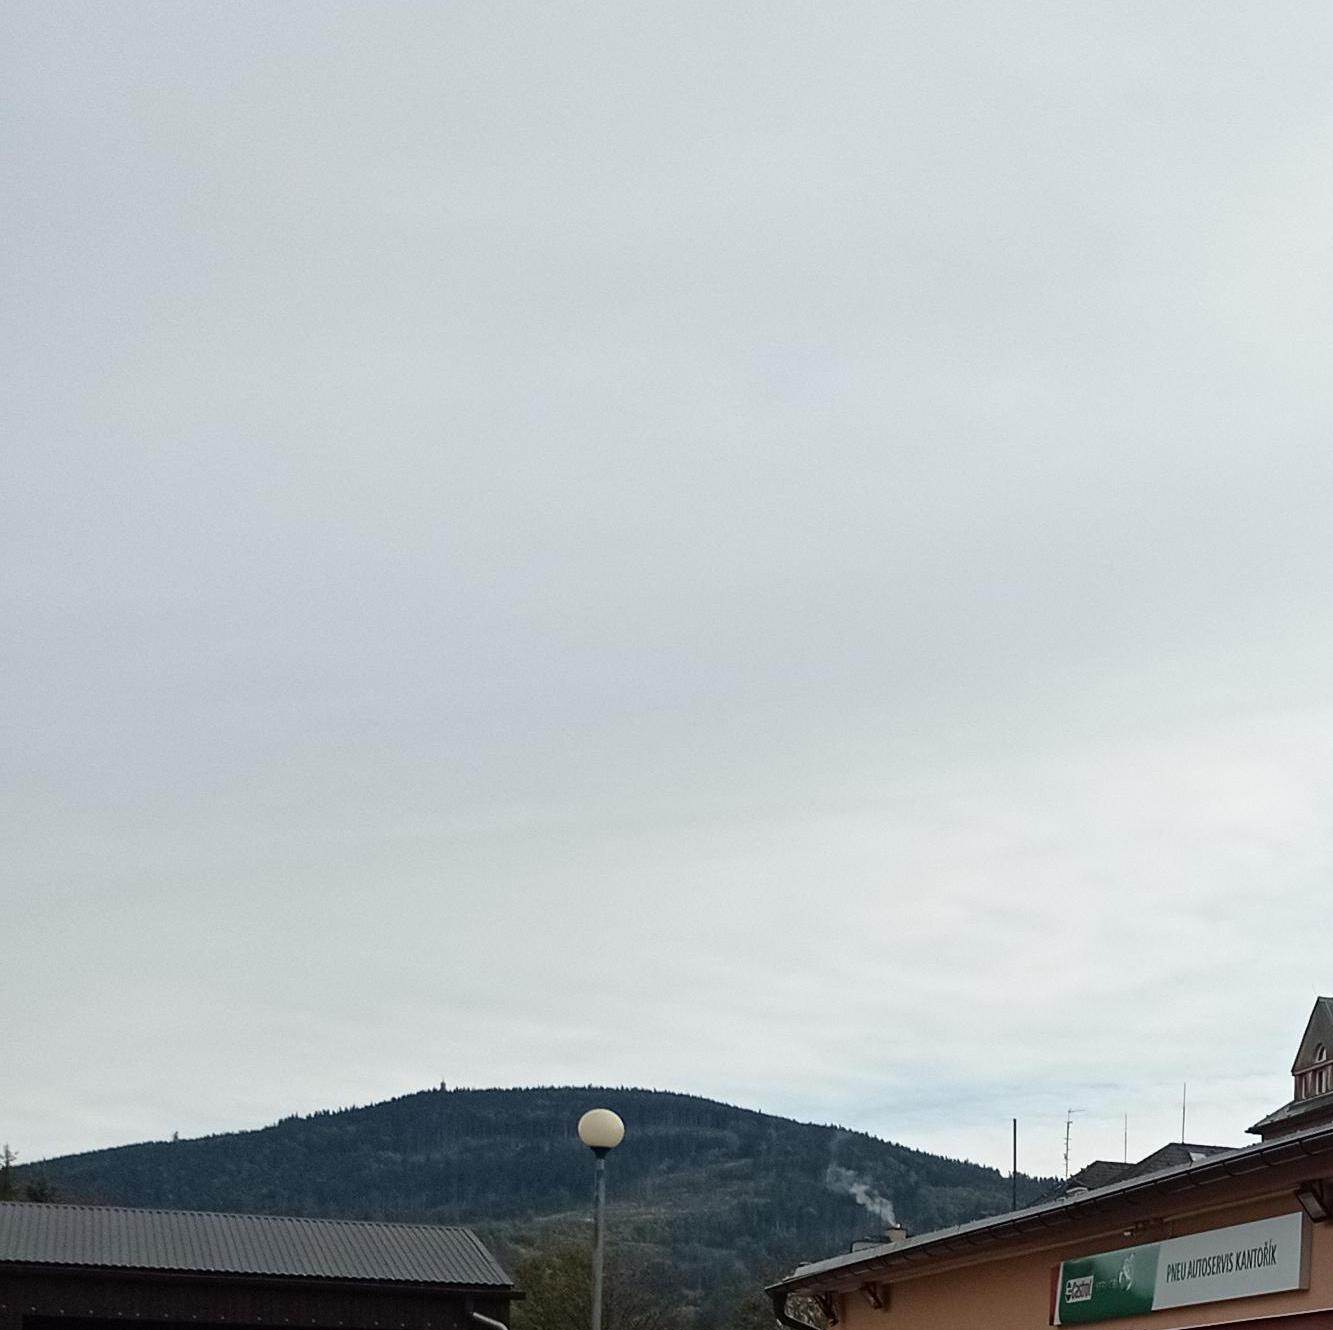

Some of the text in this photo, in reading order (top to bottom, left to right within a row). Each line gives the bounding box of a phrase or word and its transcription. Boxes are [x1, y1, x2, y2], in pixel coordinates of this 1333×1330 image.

[1166, 1238, 1277, 1284] PNEU AUTOSERVIS KANTOŘÍK
